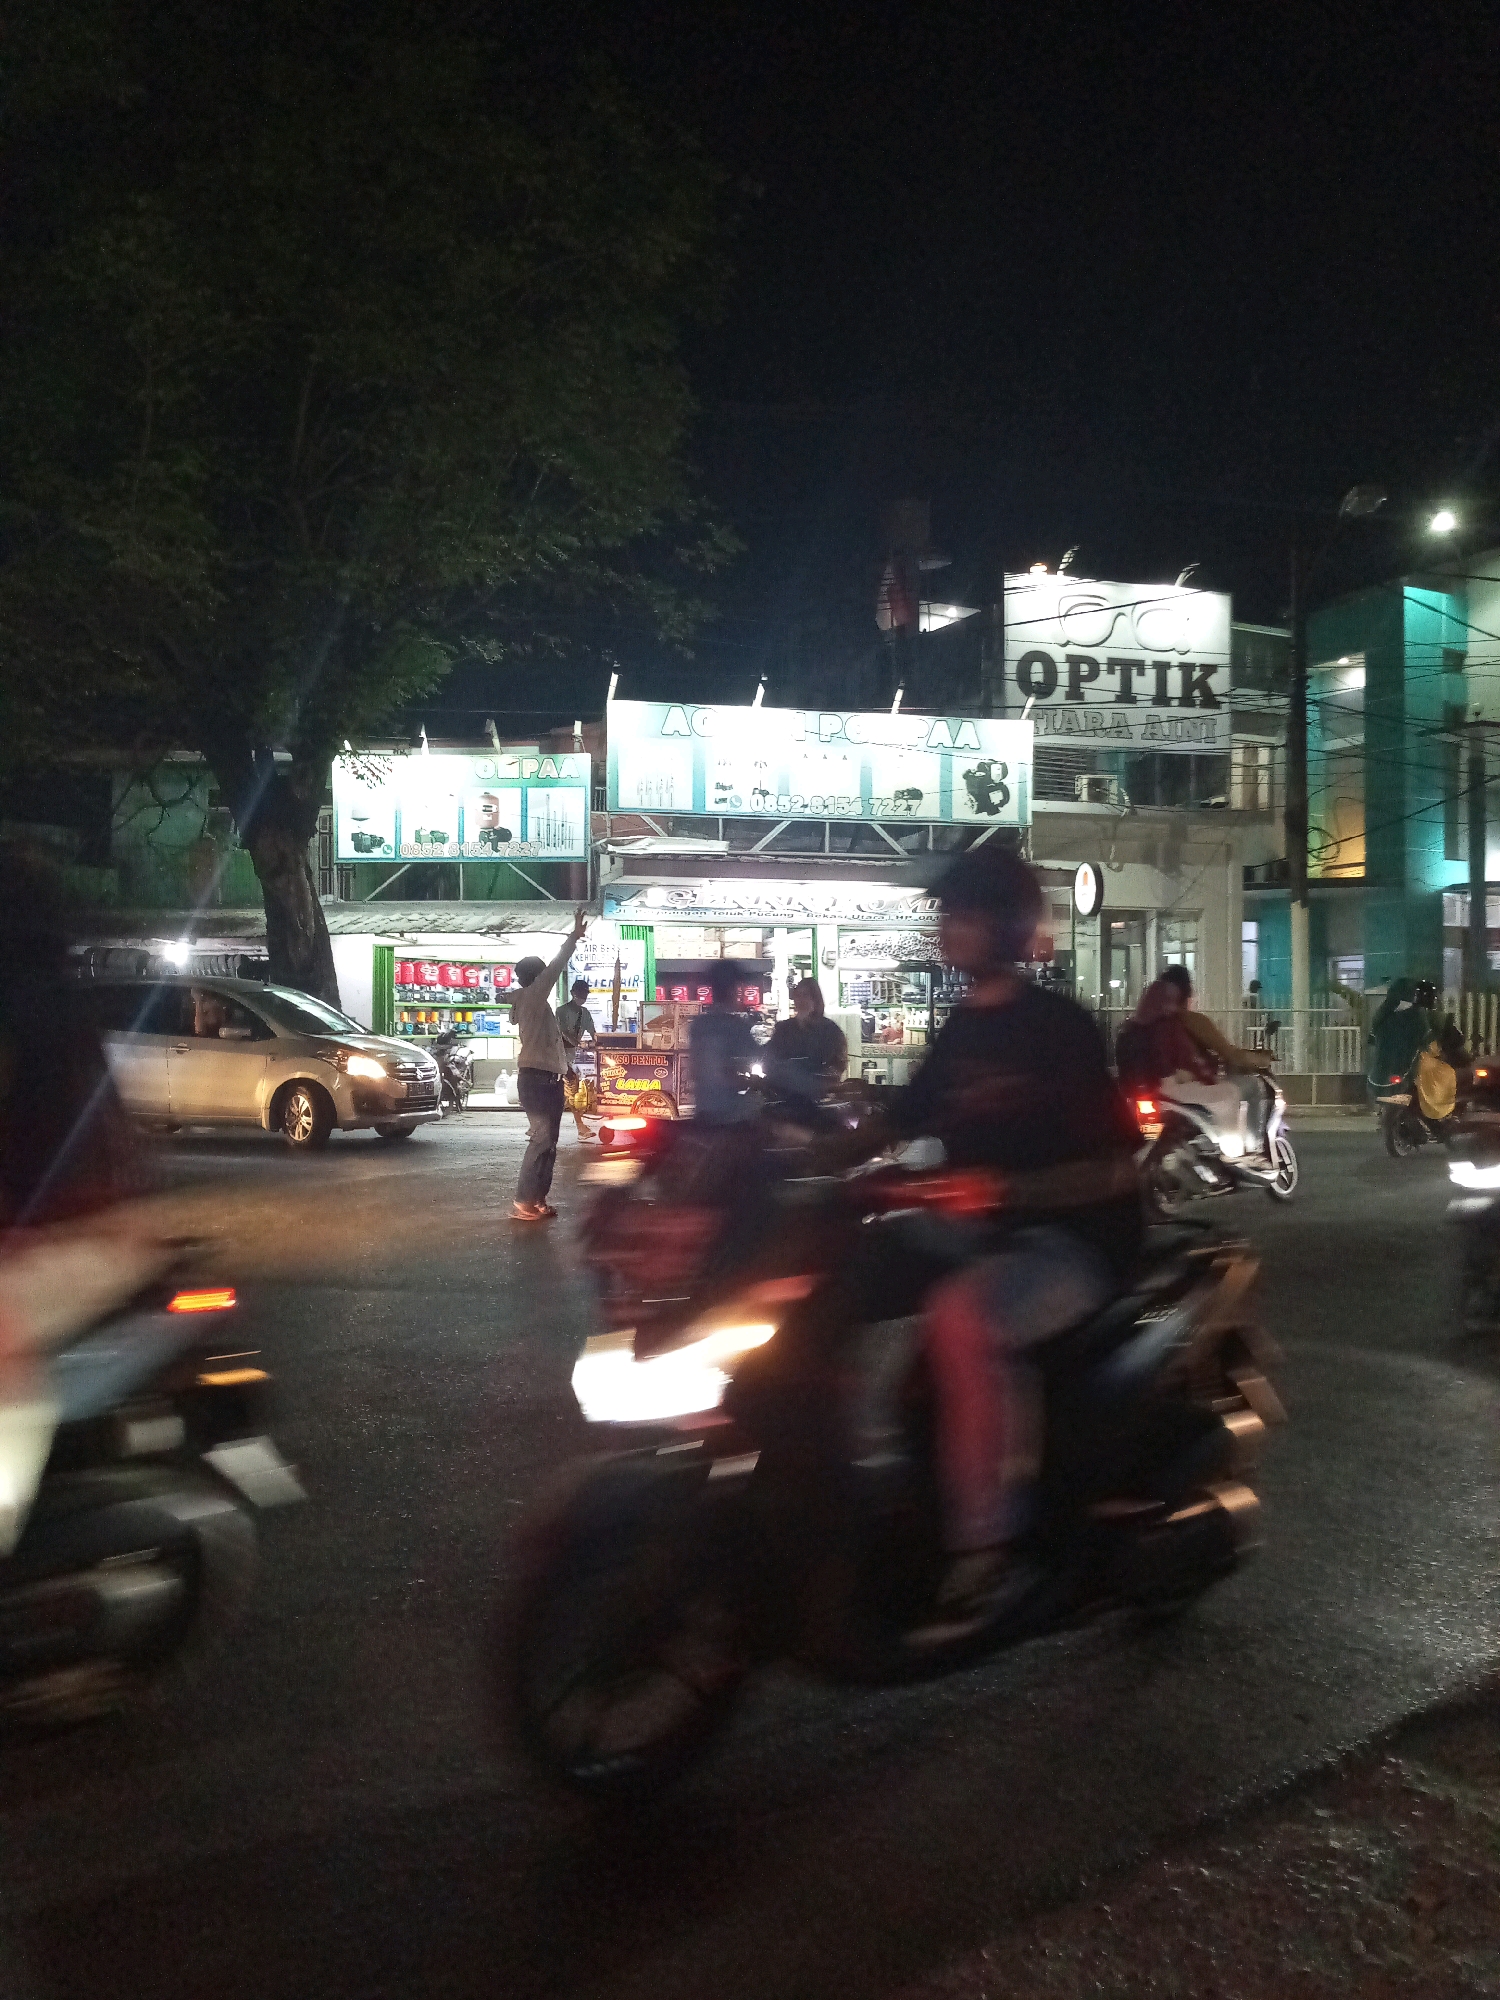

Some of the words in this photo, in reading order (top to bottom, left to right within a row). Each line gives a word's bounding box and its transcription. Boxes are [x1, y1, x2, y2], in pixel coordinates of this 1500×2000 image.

[1016, 650, 1221, 709] OPTIK
[1027, 708, 1133, 739] TIARA
[868, 797, 922, 817] 7227
[401, 841, 444, 857] 0852
[448, 841, 494, 857] 8154
[498, 842, 542, 858] 7227
[600, 1055, 630, 1066] BKSO
[631, 1055, 669, 1066] PENTOL
